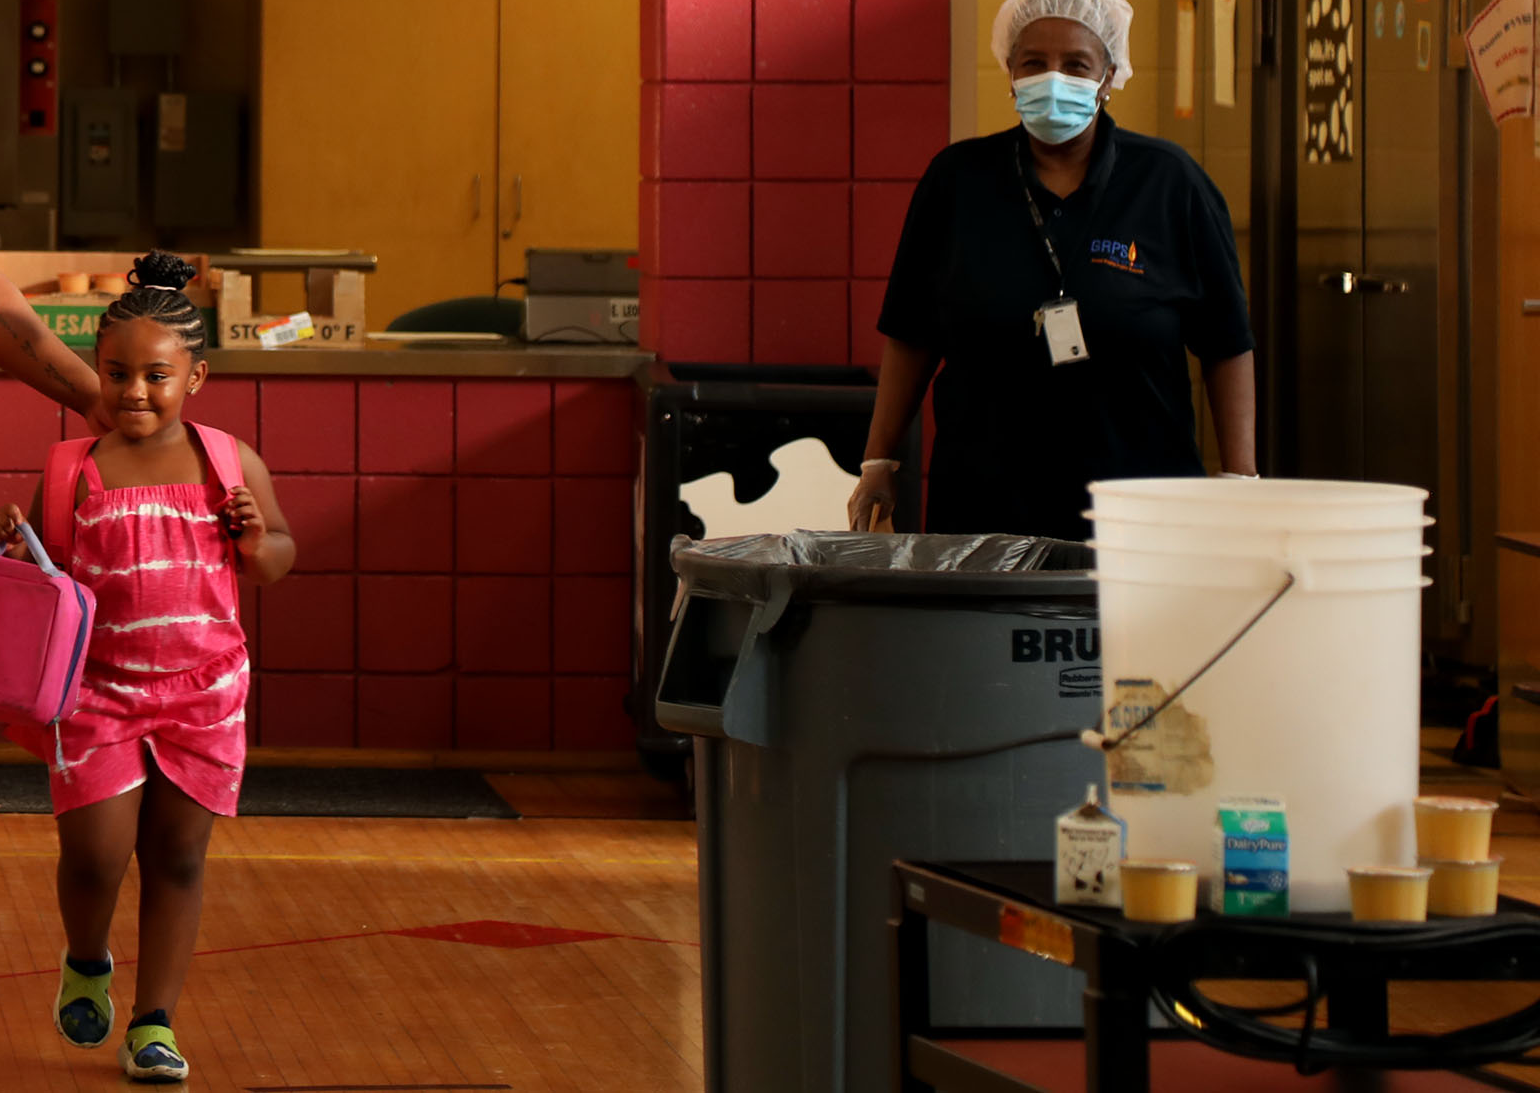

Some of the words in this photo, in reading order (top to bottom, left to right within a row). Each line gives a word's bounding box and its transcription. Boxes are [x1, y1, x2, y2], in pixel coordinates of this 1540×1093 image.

[230, 323, 261, 340] STO
[345, 324, 356, 340] F
[1012, 628, 1101, 663] BRU
[1062, 674, 1103, 683] Rubberm
